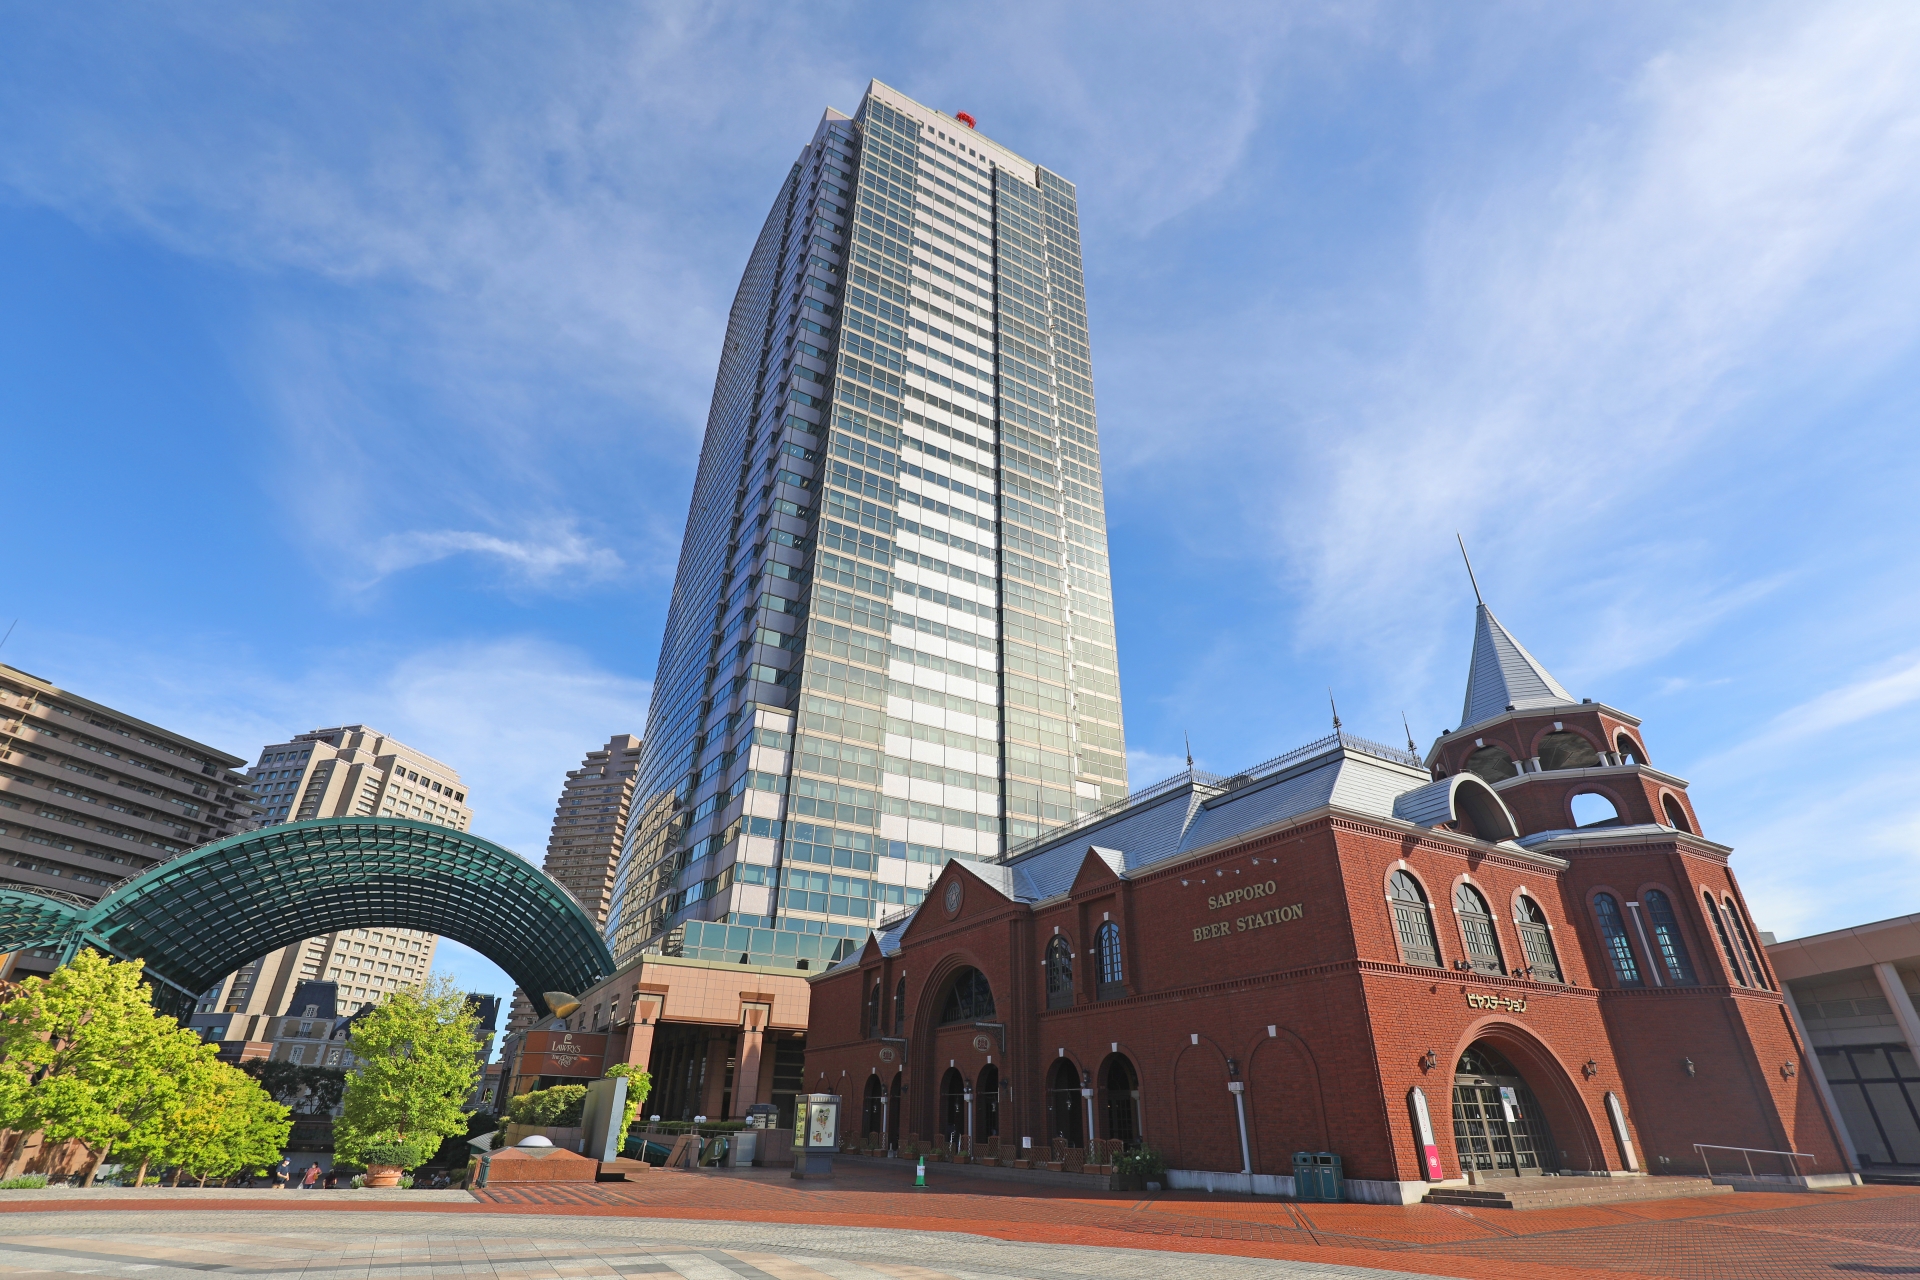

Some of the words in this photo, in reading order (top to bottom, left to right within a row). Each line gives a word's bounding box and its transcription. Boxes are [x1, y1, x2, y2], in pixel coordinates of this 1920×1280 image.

[1208, 880, 1277, 910] SAPPORO
[1192, 921, 1231, 942] BEER
[1236, 903, 1304, 932] STATION
